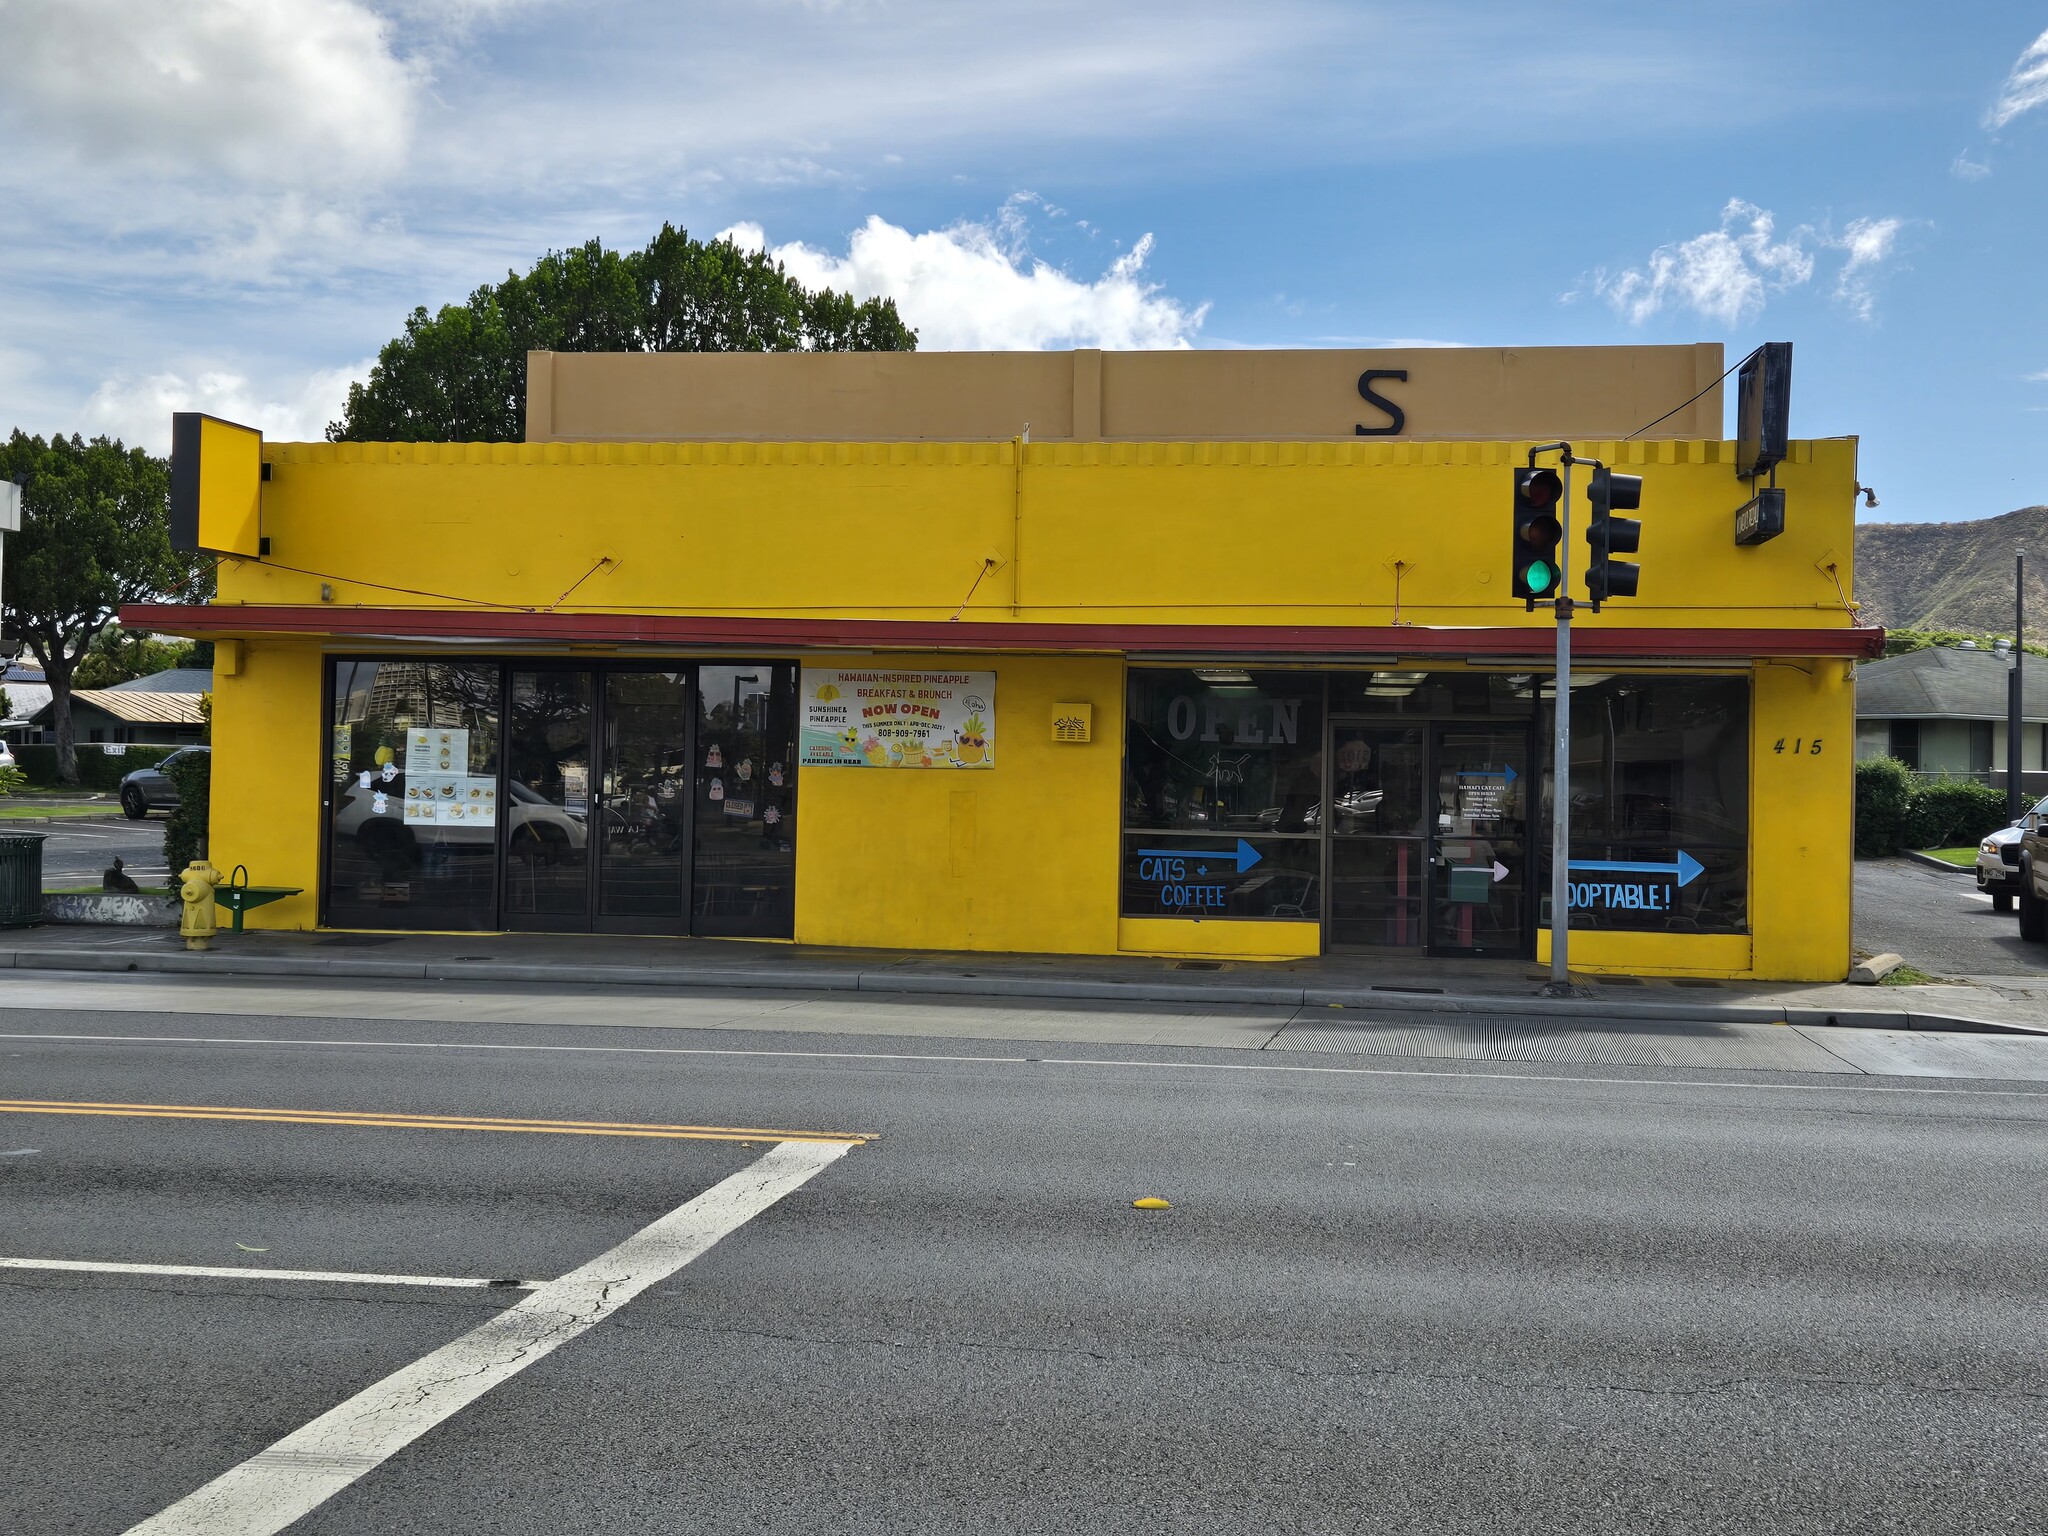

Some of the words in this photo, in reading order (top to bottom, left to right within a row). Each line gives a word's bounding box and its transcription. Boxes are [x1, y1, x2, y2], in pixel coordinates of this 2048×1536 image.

[1356, 370, 1407, 435] S
[838, 673, 922, 683] HAWAIIAN-INSPIRED
[924, 675, 970, 684] PINEAPPLE
[857, 688, 907, 698] BREAKFAST
[909, 689, 916, 698] &
[918, 690, 953, 699] BRUNCH
[810, 715, 847, 723] PINEAPPLE
[862, 703, 898, 718] NOW
[900, 703, 941, 719] OPEN
[1168, 695, 1301, 744] OPEN
[878, 728, 930, 738] 808-909-7961
[1773, 738, 1823, 755] 415
[1140, 858, 1186, 881] CATS
[1161, 884, 1226, 906] COFFEE
[1568, 883, 1670, 910] DOPTABLE!
